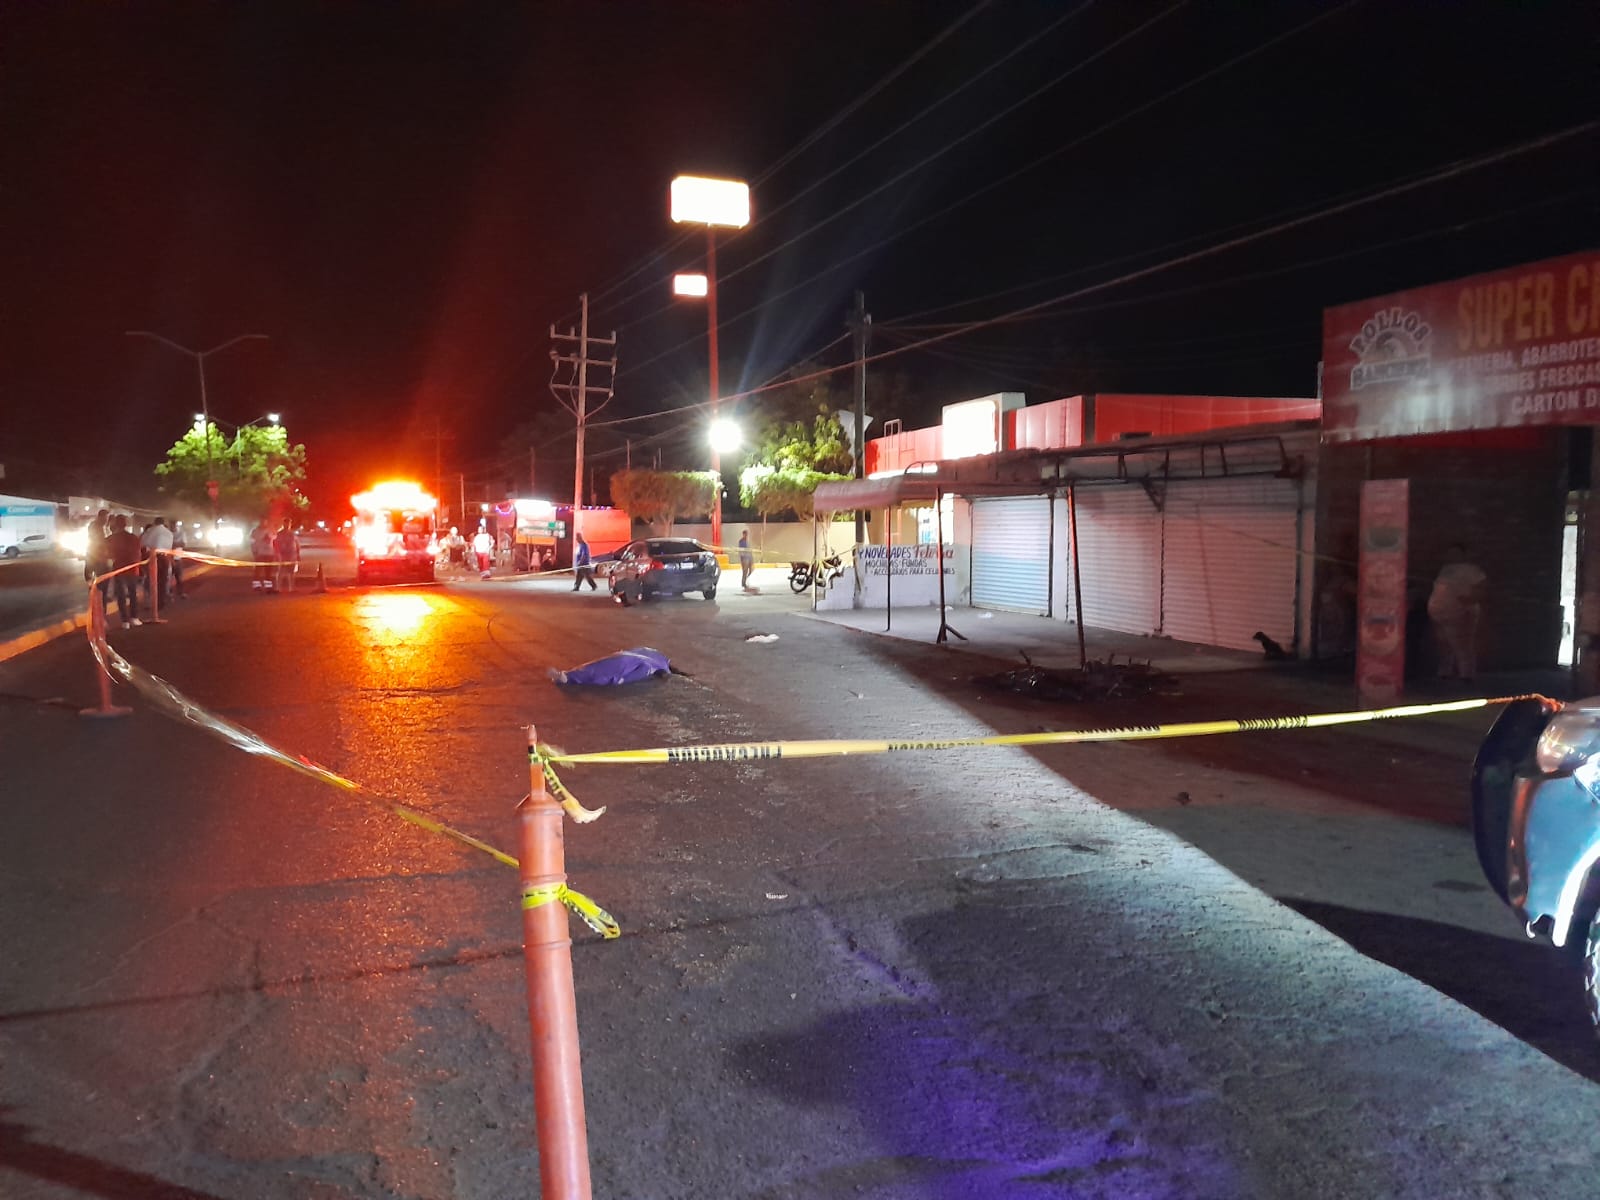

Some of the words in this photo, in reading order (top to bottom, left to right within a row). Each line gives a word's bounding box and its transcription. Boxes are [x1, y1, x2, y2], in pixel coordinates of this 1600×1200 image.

[1349, 307, 1432, 354] POLLOS
[1457, 273, 1554, 350] SUPER
[1511, 390, 1580, 416] CARTON
[1585, 387, 1600, 409] D
